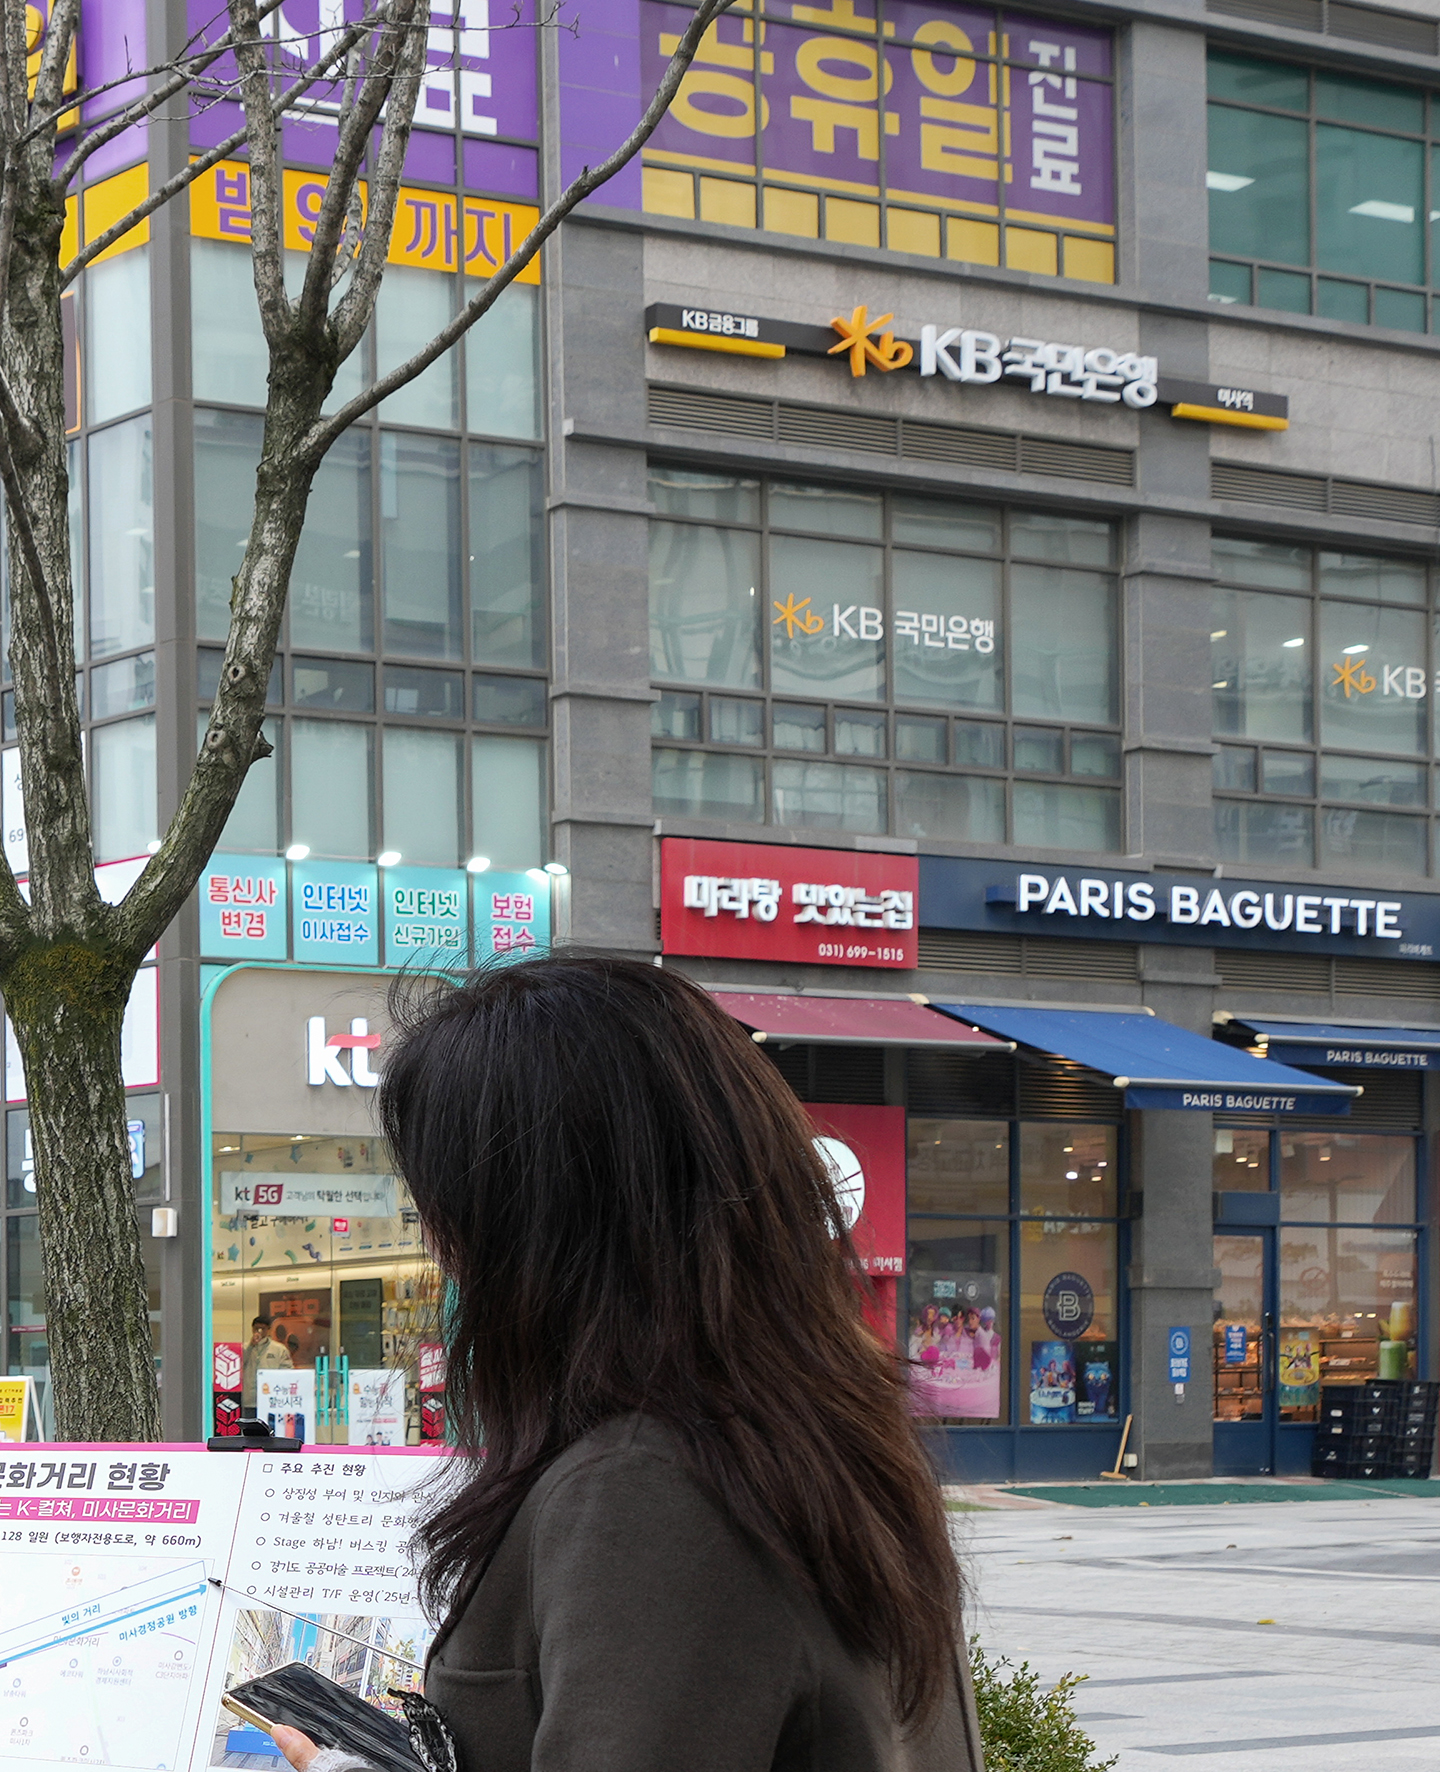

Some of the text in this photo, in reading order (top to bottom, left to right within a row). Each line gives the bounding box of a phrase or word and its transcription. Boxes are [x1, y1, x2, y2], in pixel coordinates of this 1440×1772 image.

[1028, 39, 1082, 195] 진료
[405, 199, 512, 266] 까지
[832, 602, 995, 653] KB 국민은행
[1382, 664, 1427, 698] KB
[208, 875, 534, 921] 통신사 인터넷 인터넷 보험
[793, 882, 913, 931] 맛있는집
[1017, 873, 1403, 939] PARIS BAGUETTE
[220, 909, 536, 954] 변경 이사접수 신규가입 접수
[818, 942, 904, 962] 031) 699-1515
[308, 1016, 381, 1088] kt
[1327, 1051, 1428, 1066] PARIS BAGUETTE
[1182, 1092, 1296, 1111] PARIS BAGUETTE
[107, 1462, 170, 1491] 현황
[280, 1463, 366, 1476] 주요 추진 현황
[82, 1500, 191, 1521] 미사문화거리
[28, 1530, 49, 1544] 일원
[144, 1534, 155, 1546] 약
[162, 1533, 202, 1548] 660m)
[119, 1605, 198, 1642] 미사경정공원 방향
